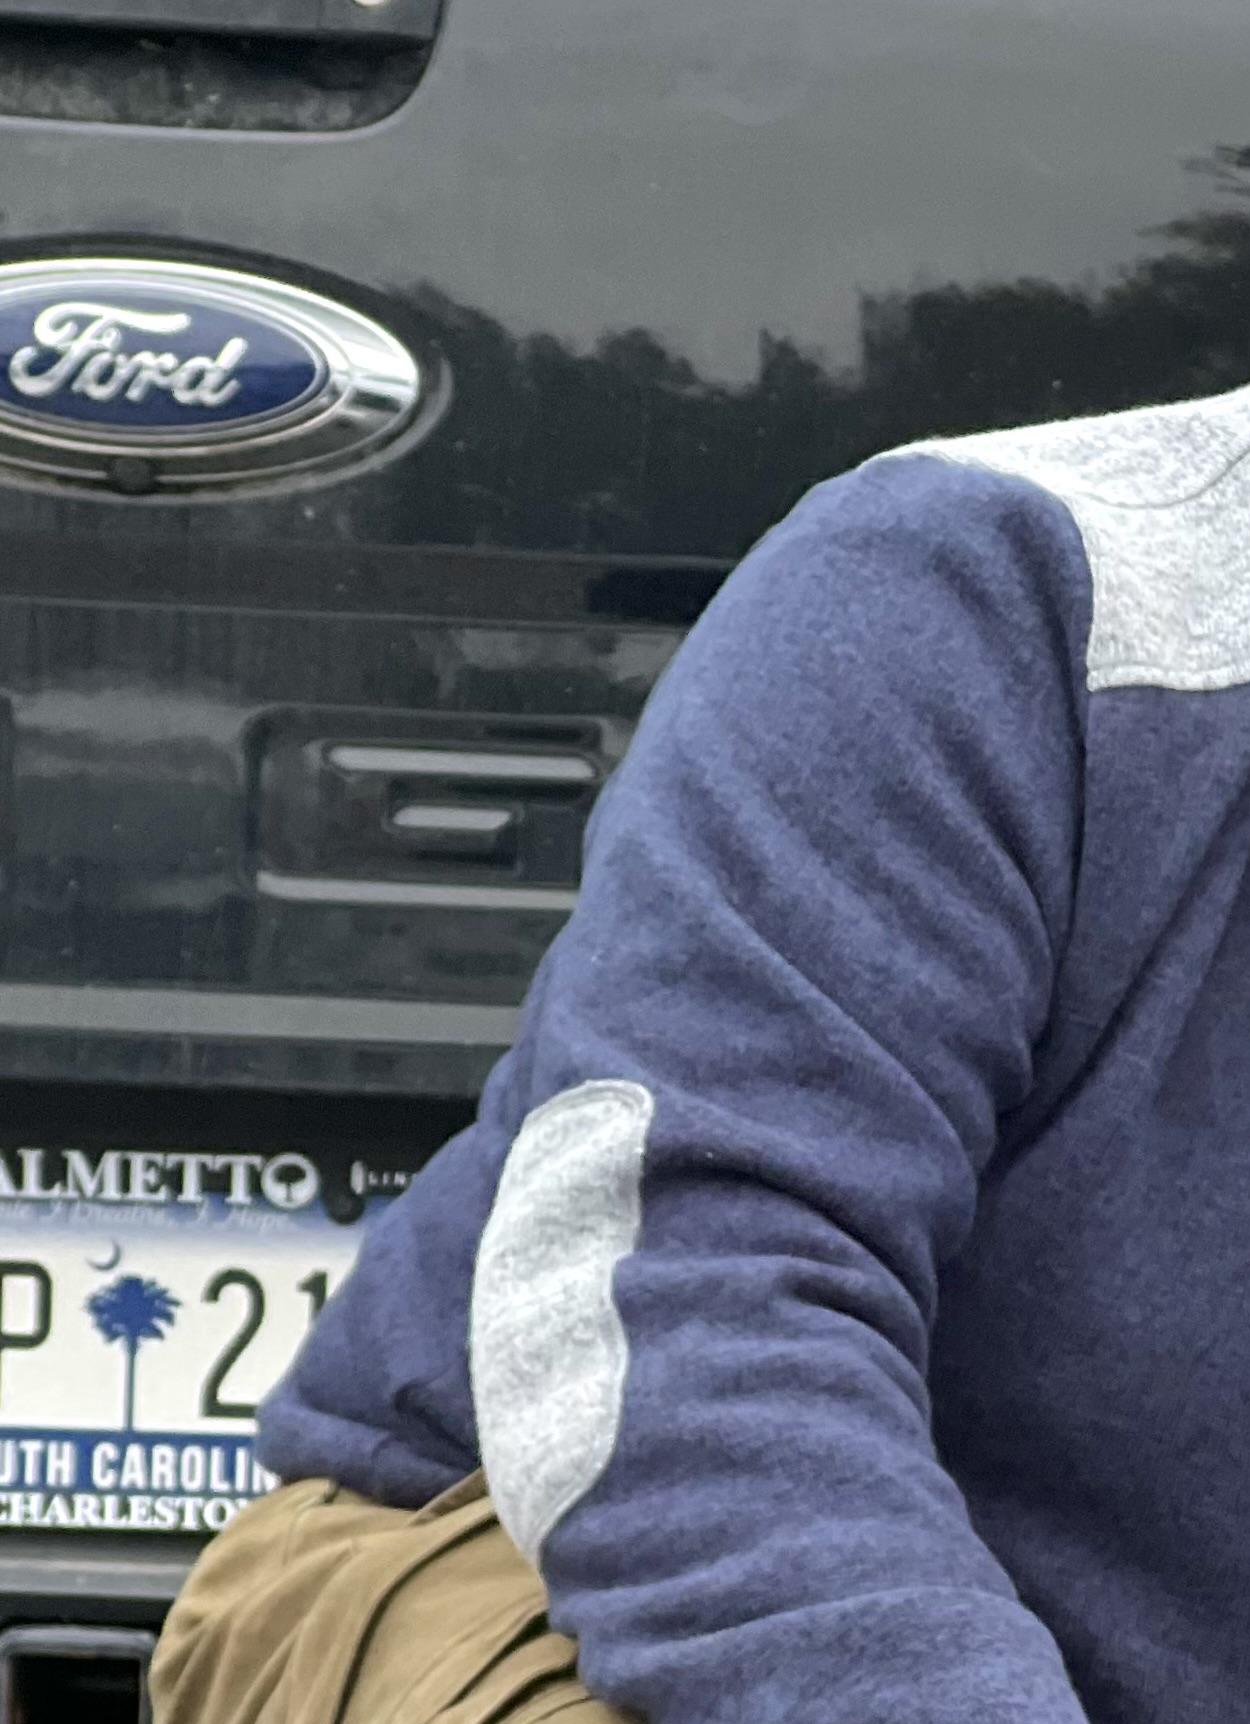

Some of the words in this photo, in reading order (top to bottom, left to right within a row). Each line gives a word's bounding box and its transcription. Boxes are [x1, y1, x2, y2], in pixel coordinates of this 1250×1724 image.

[8, 302, 248, 406] Ford
[0, 1260, 53, 1400] P
[0, 1491, 248, 1532] HARLESTO
